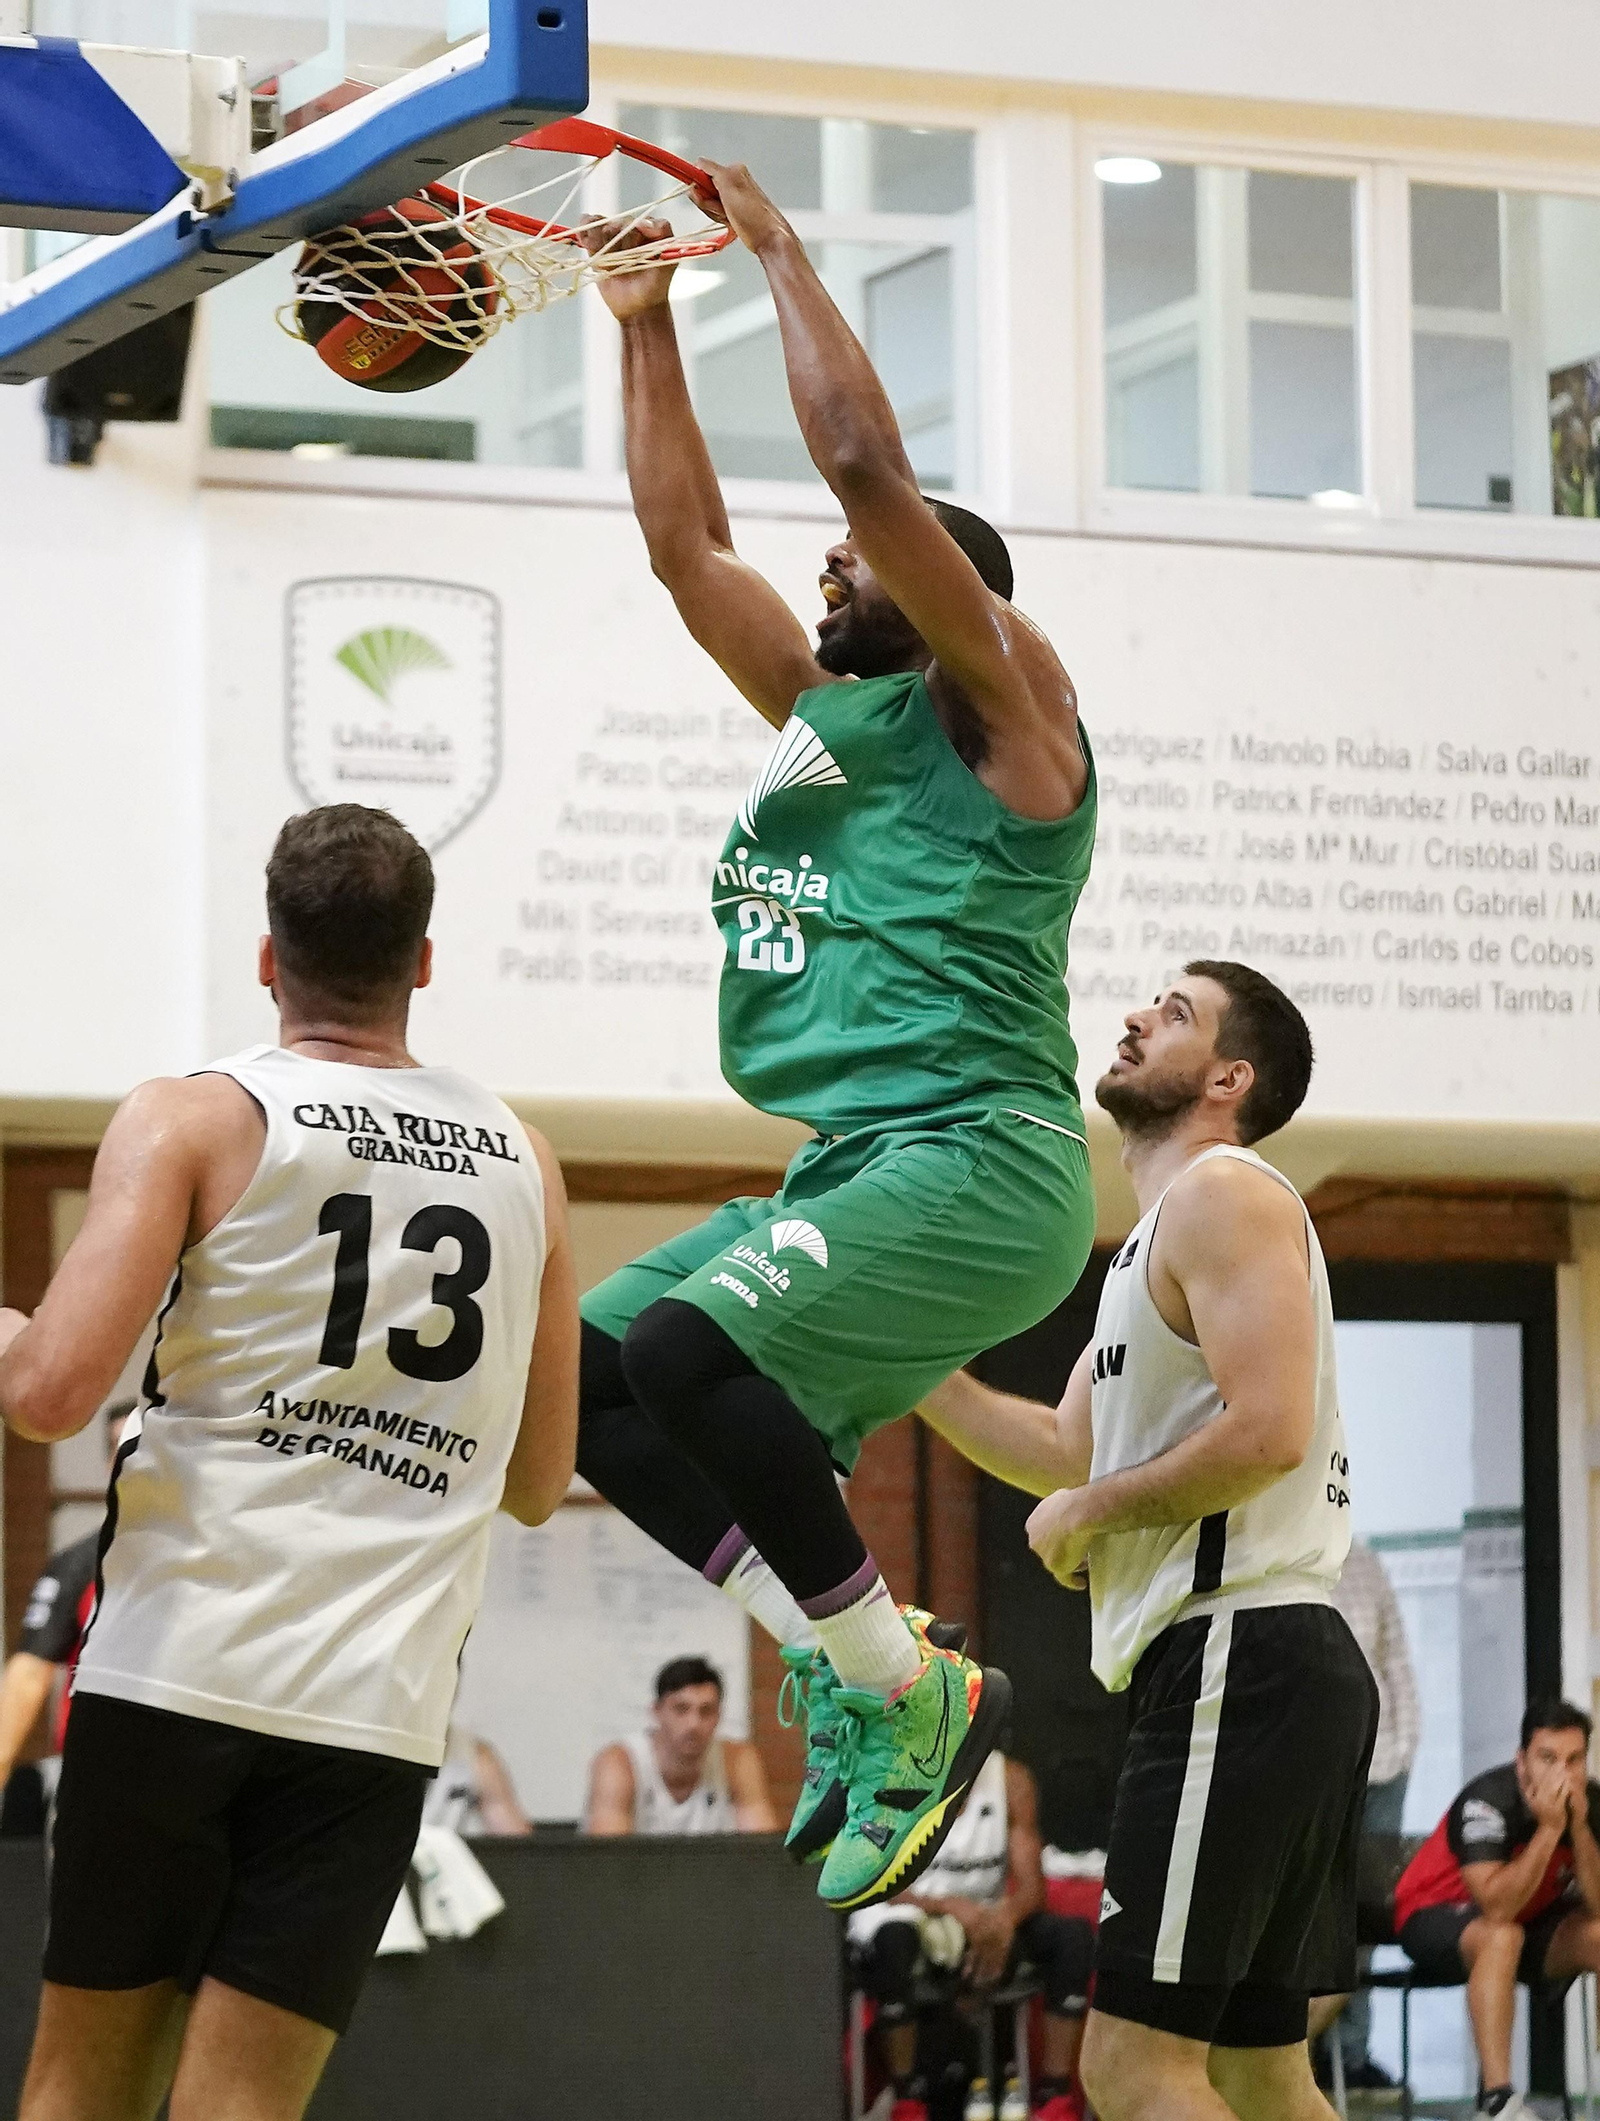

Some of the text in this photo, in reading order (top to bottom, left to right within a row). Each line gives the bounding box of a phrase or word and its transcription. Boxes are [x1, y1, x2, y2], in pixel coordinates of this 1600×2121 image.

[1230, 734, 1328, 768] Manolo
[1335, 736, 1412, 772] Rubia
[1437, 741, 1509, 778] Salva
[1516, 745, 1591, 780] Gallar
[1099, 774, 1189, 813] Portillo
[1212, 779, 1301, 816] Patrick
[1309, 783, 1446, 822] Fernández
[1471, 791, 1546, 828] Pedro
[717, 846, 829, 907] nicaja
[1237, 828, 1297, 865] José
[1349, 833, 1399, 868] Mur
[1424, 836, 1539, 876] Cristóbal
[1120, 873, 1249, 914] Alejandro
[1252, 879, 1314, 912] Alba
[1338, 879, 1446, 916] Germán
[1453, 884, 1548, 922] Gabriel
[737, 899, 806, 974] 23
[1142, 920, 1221, 956] Pablo
[1227, 925, 1346, 960] Almazán
[1373, 928, 1461, 966] Carlos
[1467, 932, 1502, 967] de
[1510, 934, 1595, 974] Cobos
[1398, 978, 1481, 1013] Ismael
[1489, 979, 1575, 1017] Tamba
[293, 1103, 520, 1164] CAJA RURAL
[347, 1136, 480, 1177] GRANADA
[317, 1192, 492, 1383] 13
[252, 1390, 478, 1464] AYUNTAMIENTO
[256, 1427, 449, 1498] DE GRANADA
